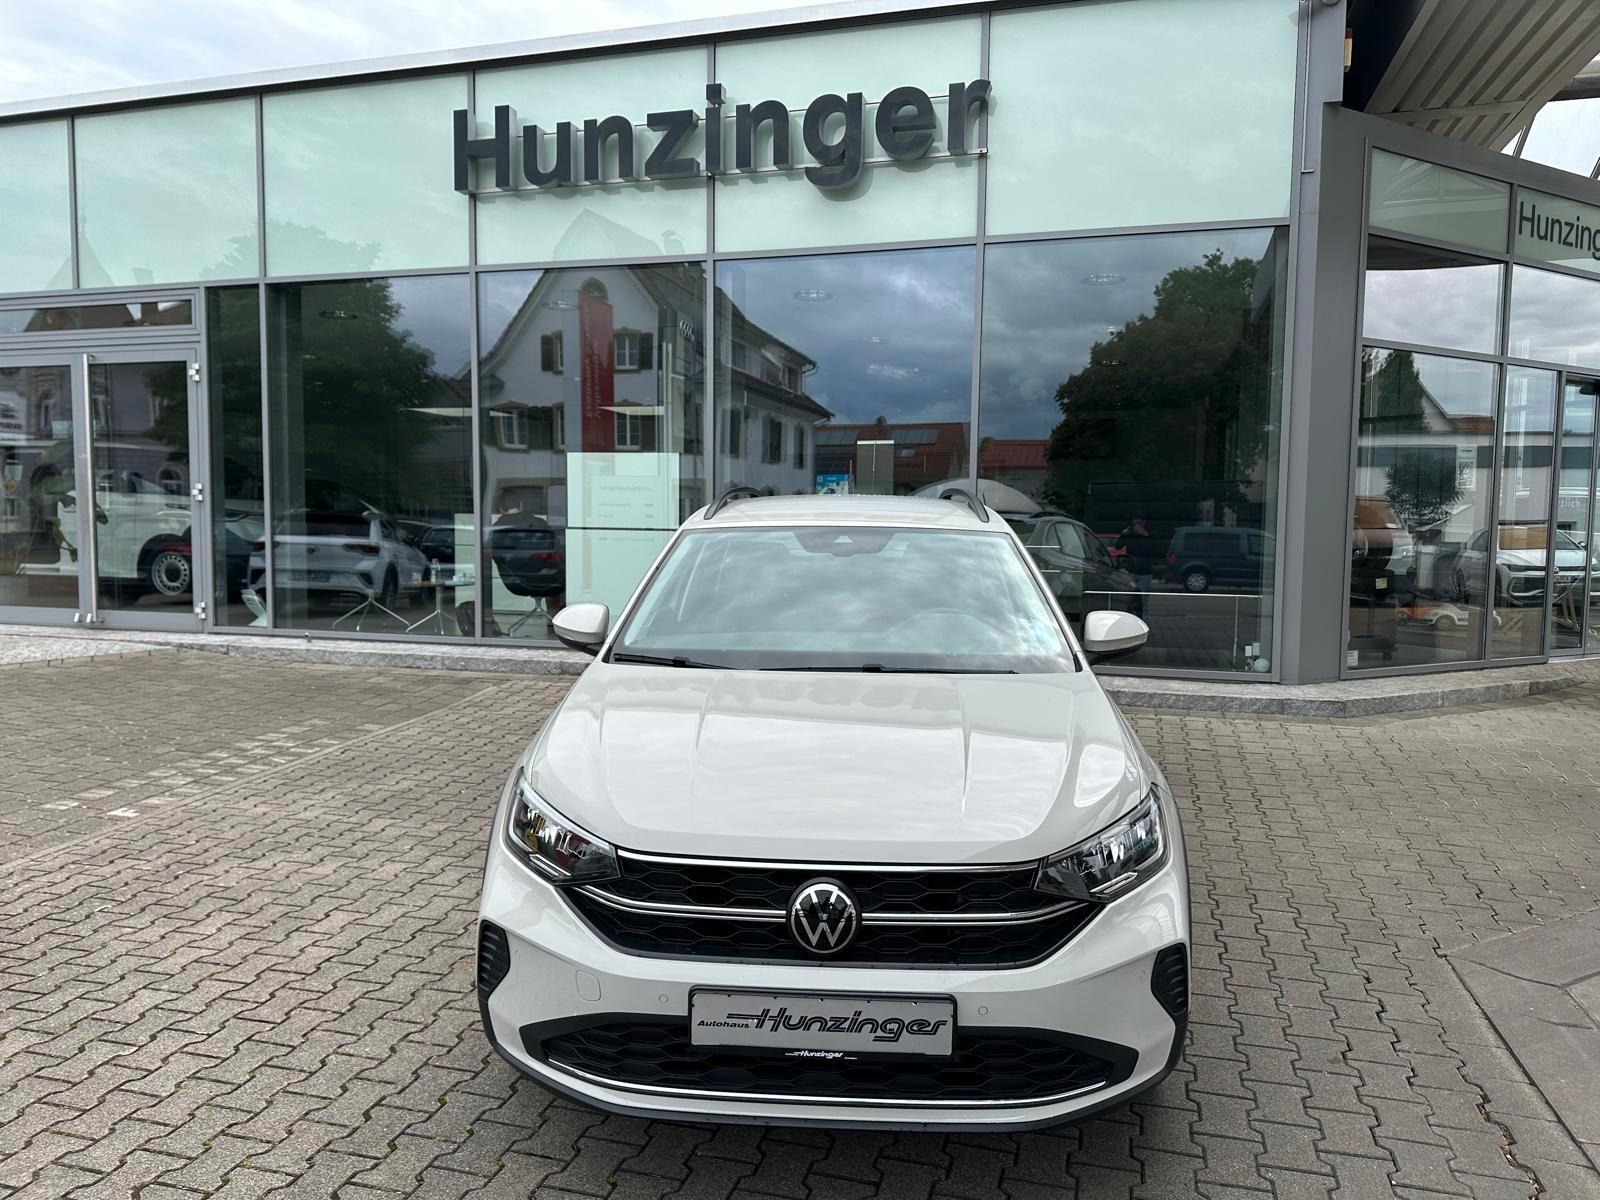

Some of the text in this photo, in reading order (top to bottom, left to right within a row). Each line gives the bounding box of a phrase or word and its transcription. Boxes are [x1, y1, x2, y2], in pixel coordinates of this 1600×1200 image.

[453, 79, 992, 194] Hunzinger
[792, 884, 856, 952] VW
[697, 1007, 948, 1042] Autohaus Hunzinger
[794, 1050, 843, 1059] Hunzinger
